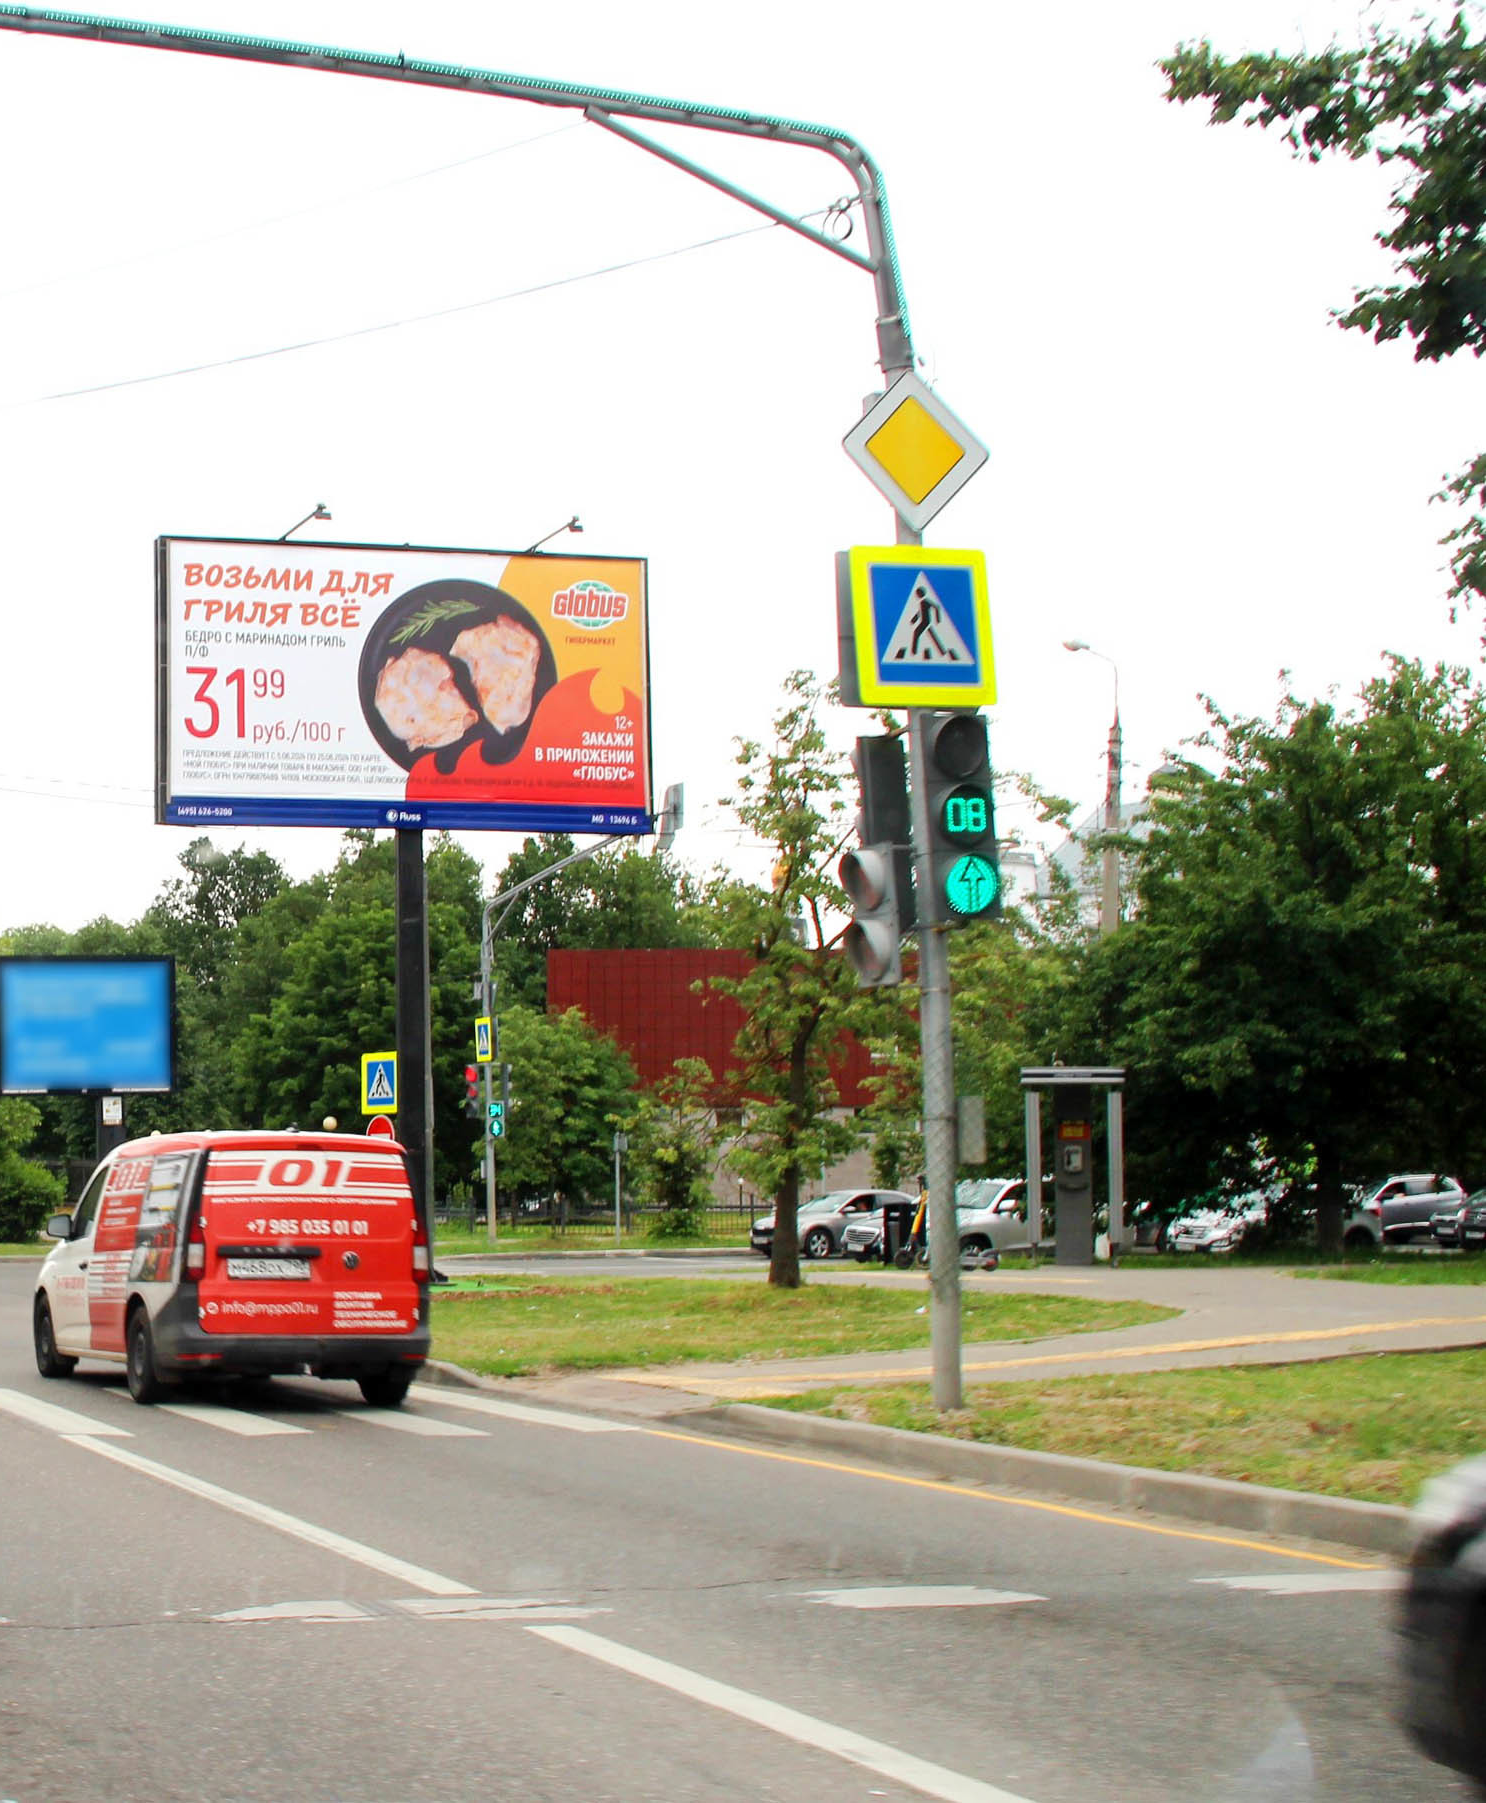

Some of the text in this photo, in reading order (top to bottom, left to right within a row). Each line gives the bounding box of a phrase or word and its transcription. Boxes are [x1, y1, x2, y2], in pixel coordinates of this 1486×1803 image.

[183, 563, 394, 598] ВОЗЬМИ ДЛЯ
[183, 598, 361, 628] ГРИЛЯ ВСЁ
[185, 630, 346, 648] БЕДРО С МАРИНАДОМ ГРИЛЬ
[185, 644, 209, 658] П/Ф
[184, 666, 285, 739] 31 99
[253, 719, 346, 744] руб./100 г
[615, 716, 633, 729] 12+
[582, 732, 634, 747] ЗАКАЖИ
[535, 747, 634, 764] В ПРИЛОЖЕНИИ
[573, 766, 635, 781] «ГЛОБУС»
[947, 797, 987, 832] 08
[268, 1158, 346, 1188] 01
[246, 1219, 369, 1236] +7 985 035 01 01
